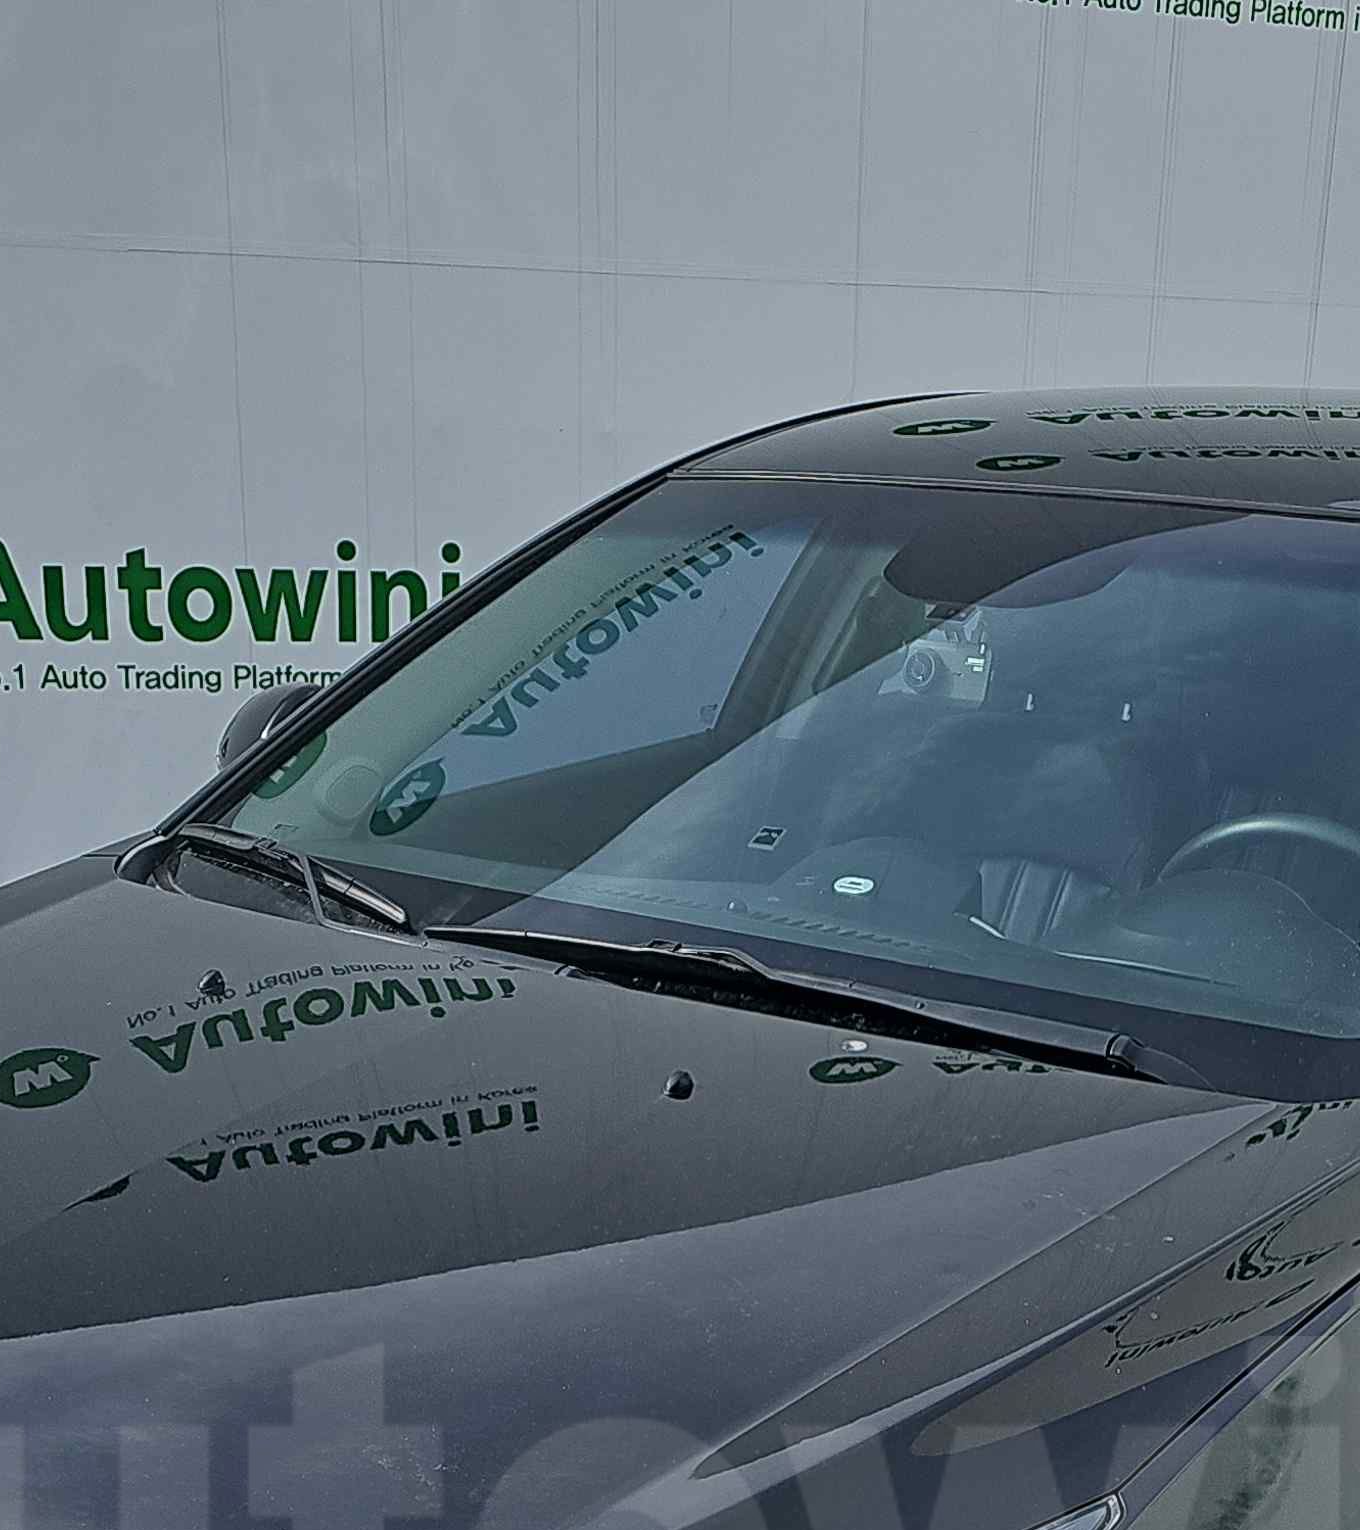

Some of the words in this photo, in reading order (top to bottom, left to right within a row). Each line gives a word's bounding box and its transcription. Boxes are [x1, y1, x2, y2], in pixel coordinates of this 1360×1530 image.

[1249, 0, 1344, 30] Platform
[40, 664, 107, 690] Auto
[117, 664, 223, 693] Trading
